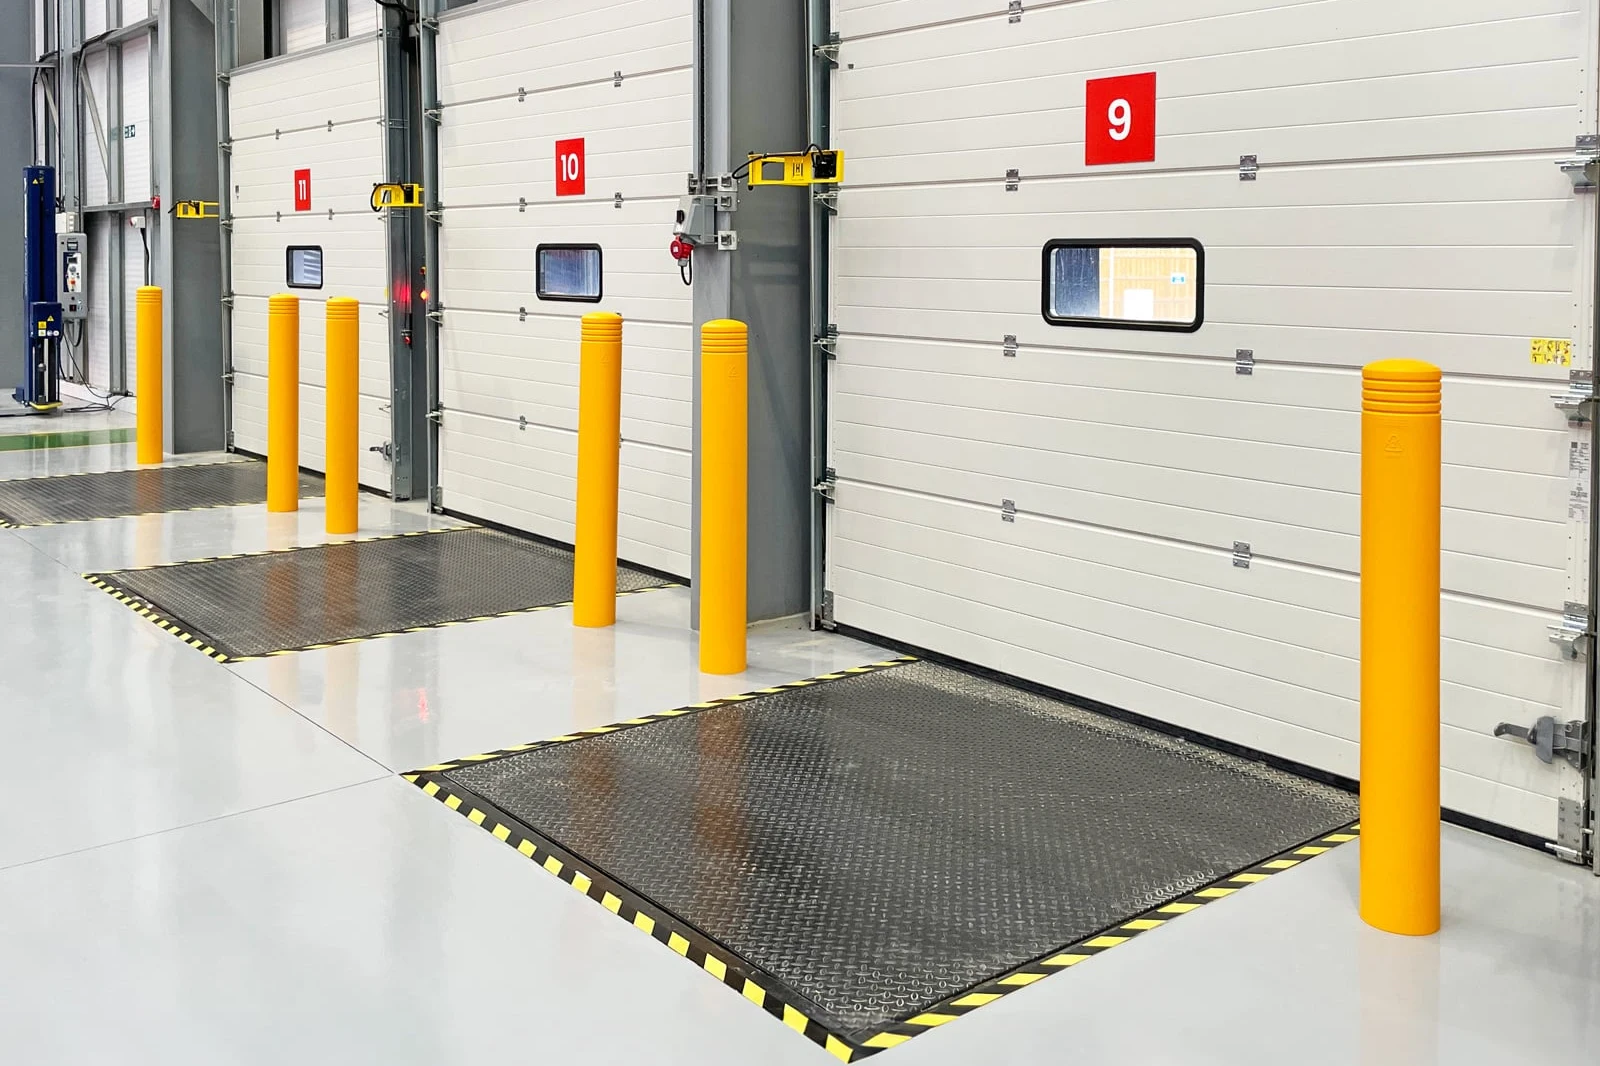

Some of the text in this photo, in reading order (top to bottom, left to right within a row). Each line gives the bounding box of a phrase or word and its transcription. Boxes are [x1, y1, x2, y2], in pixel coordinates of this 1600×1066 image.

[1107, 98, 1132, 141] 9
[560, 153, 579, 182] 10
[298, 179, 307, 201] 11
